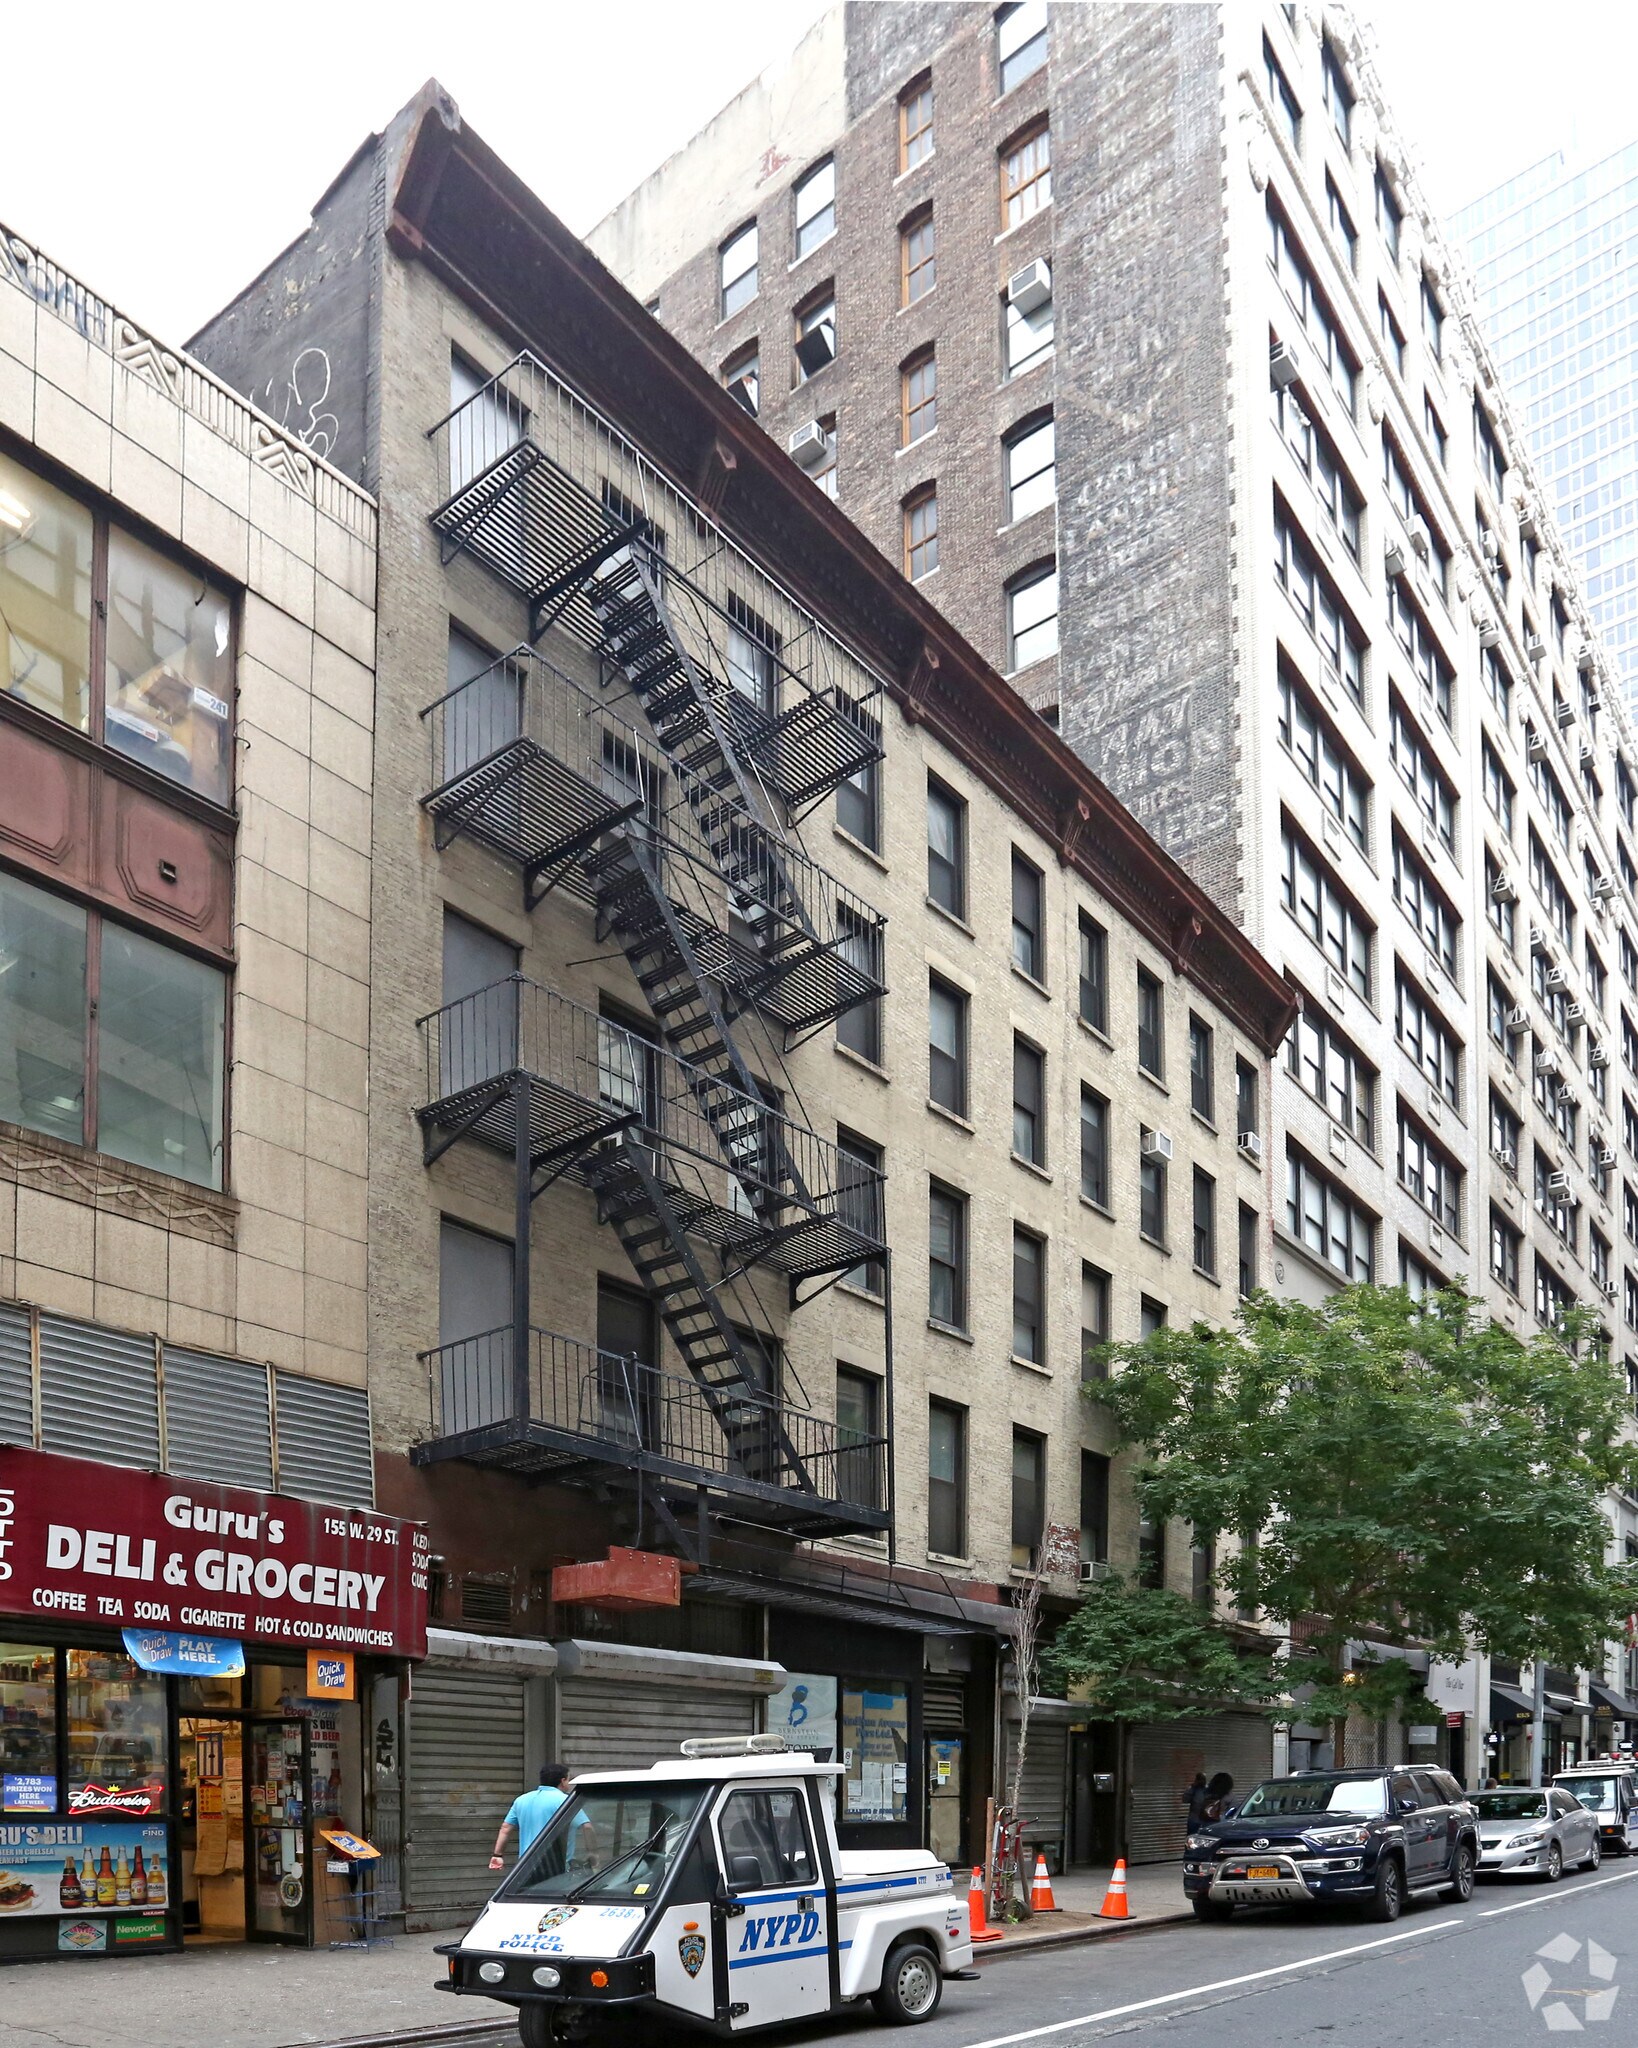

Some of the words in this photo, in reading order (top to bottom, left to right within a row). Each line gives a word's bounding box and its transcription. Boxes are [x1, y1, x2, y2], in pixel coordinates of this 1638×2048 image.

[210, 698, 227, 717] 241
[164, 1495, 285, 1544] Guru's
[324, 1517, 346, 1536] 155
[350, 1523, 364, 1540] W.
[367, 1525, 382, 1542] 29
[384, 1529, 399, 1545] ST.
[412, 1531, 428, 1550] ICED
[46, 1524, 157, 1582] DELI
[162, 1552, 188, 1587] &
[194, 1548, 386, 1613] GROCERY
[411, 1551, 429, 1570] SODA
[32, 1587, 87, 1612] COFFEE
[97, 1596, 123, 1616] TEA
[133, 1600, 170, 1622] SODA
[180, 1606, 246, 1630] CIGARETTE
[255, 1615, 281, 1634] HOT
[282, 1619, 290, 1636] &
[293, 1620, 324, 1639] COLD
[325, 1624, 394, 1647] SANDWICHES
[142, 1635, 168, 1652] Quick
[178, 1639, 214, 1651] PLAY
[151, 1646, 173, 1663] Draw
[178, 1650, 222, 1665] HERE.
[317, 1661, 341, 1678] Quick
[325, 1672, 346, 1688] Draw
[320, 1720, 336, 1730] DELI
[778, 1727, 818, 1735] BERNSTEIN
[322, 1732, 340, 1741] BEER
[19, 1792, 40, 1800] HERE
[44, 1826, 83, 1845] DELI
[15, 1848, 24, 1856] IN
[600, 1907, 631, 1919] 2638
[116, 1924, 157, 1934] Newport
[738, 1911, 820, 1952] NYPD
[499, 1940, 565, 1952] POLICE
[511, 1934, 562, 1943] NYPD
